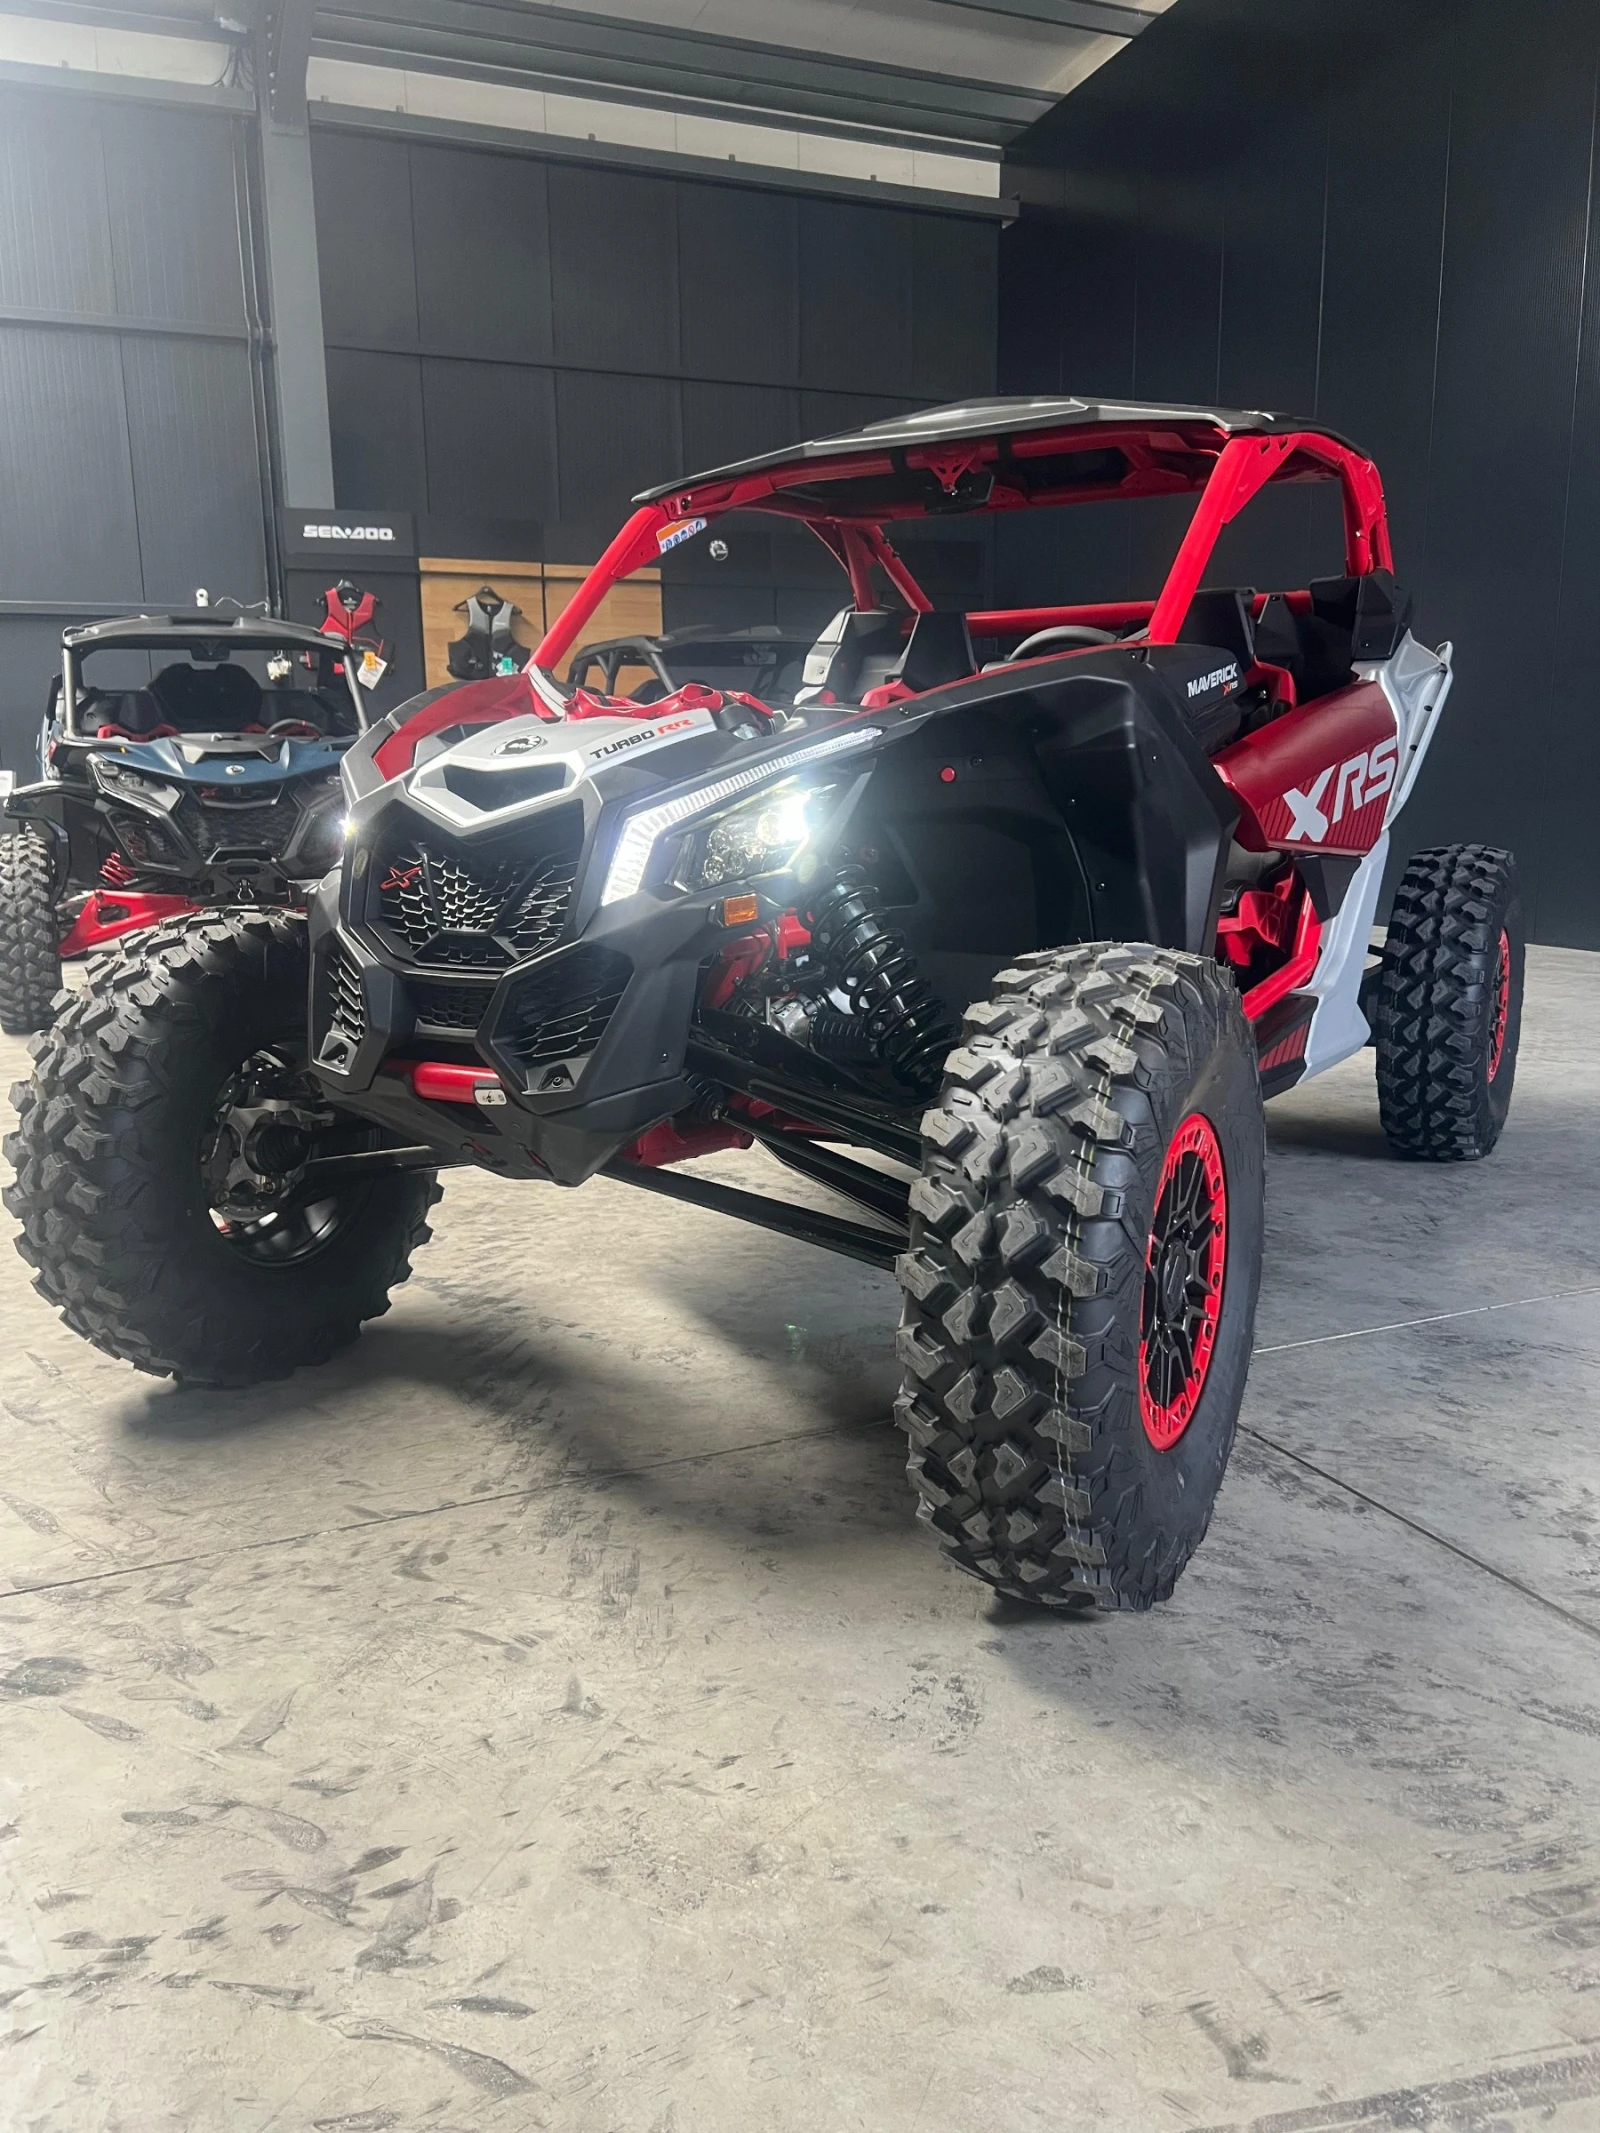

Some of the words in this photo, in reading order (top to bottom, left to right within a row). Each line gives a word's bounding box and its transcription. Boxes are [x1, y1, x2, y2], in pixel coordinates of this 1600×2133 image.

[1187, 662, 1238, 698] MAVERICK
[589, 729, 655, 759] TURBO
[657, 719, 695, 735] RR
[1282, 734, 1397, 843] XRS
